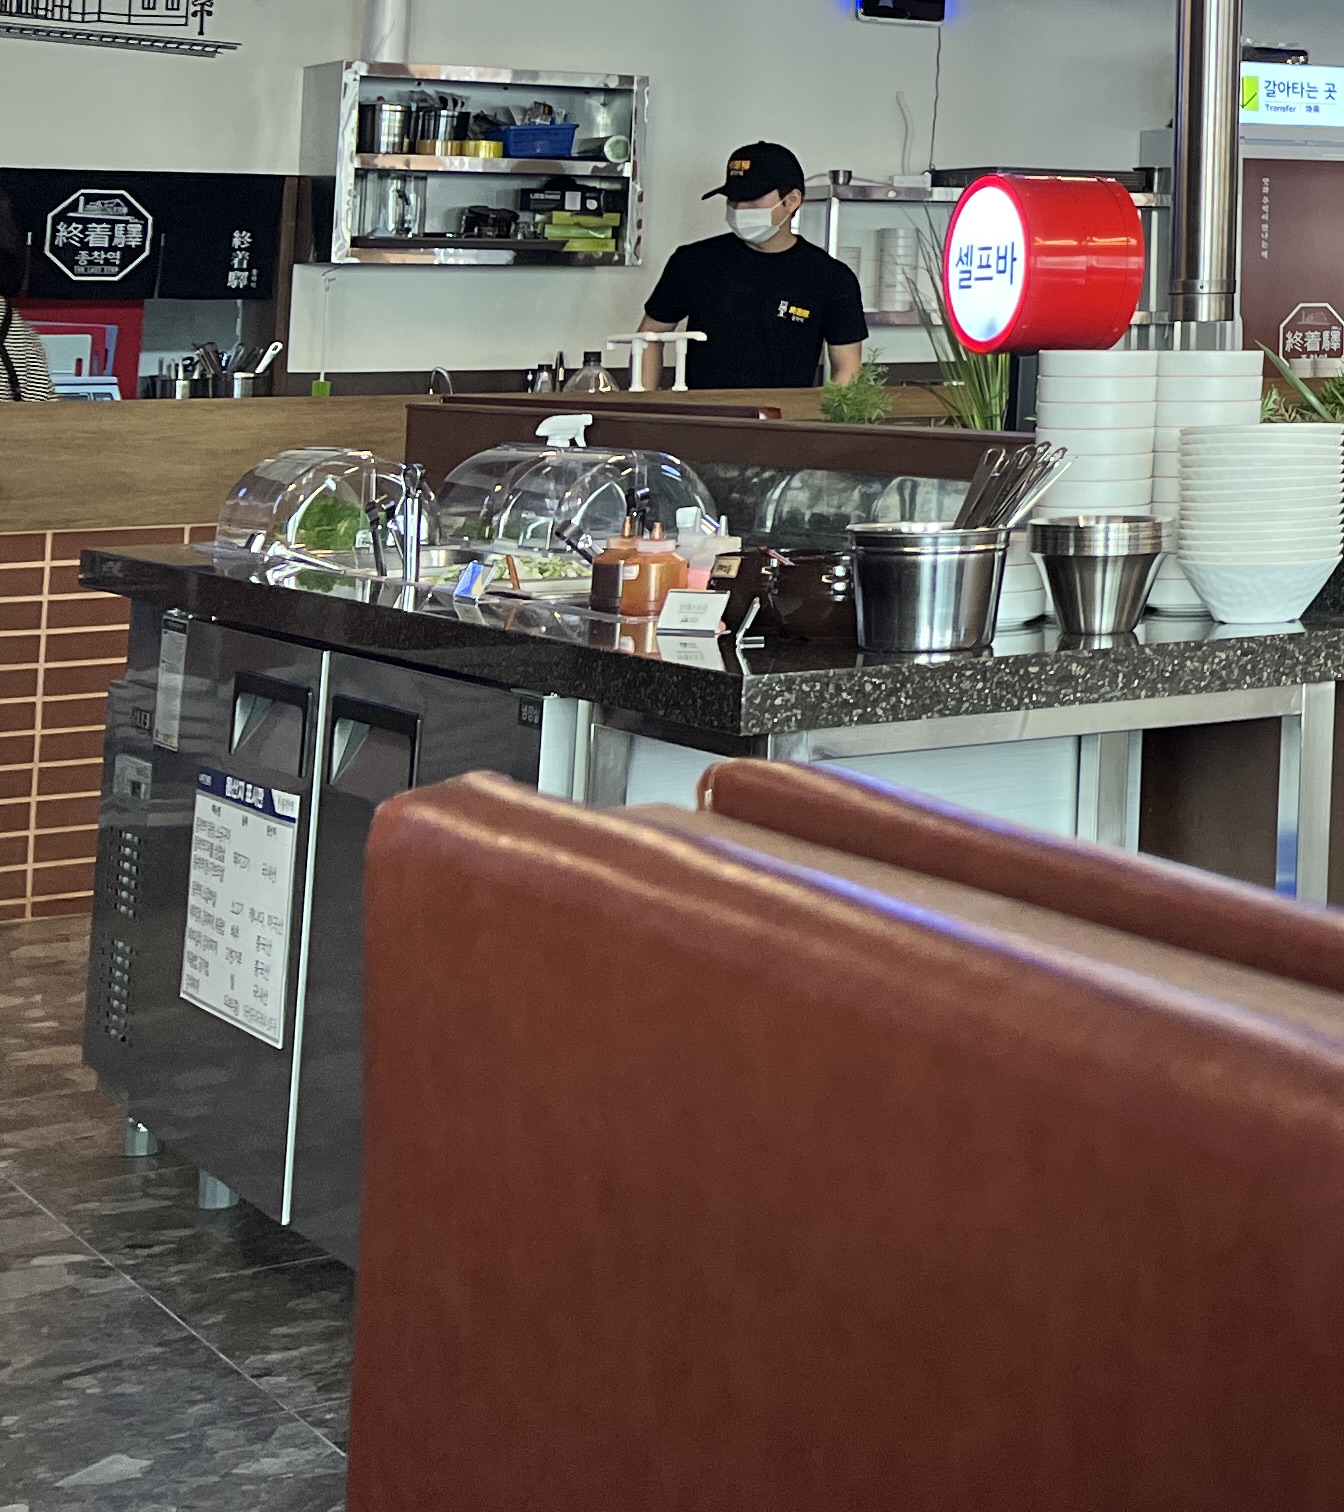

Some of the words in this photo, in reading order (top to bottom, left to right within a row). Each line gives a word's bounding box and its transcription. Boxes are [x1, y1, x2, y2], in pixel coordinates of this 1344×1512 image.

[1264, 80, 1319, 100] 갈아타는
[1323, 82, 1338, 100] 곳
[1264, 103, 1297, 114] Transfer
[54, 221, 144, 248] 終着驛
[74, 250, 121, 266] 종착역
[955, 241, 1018, 290] 셀프바
